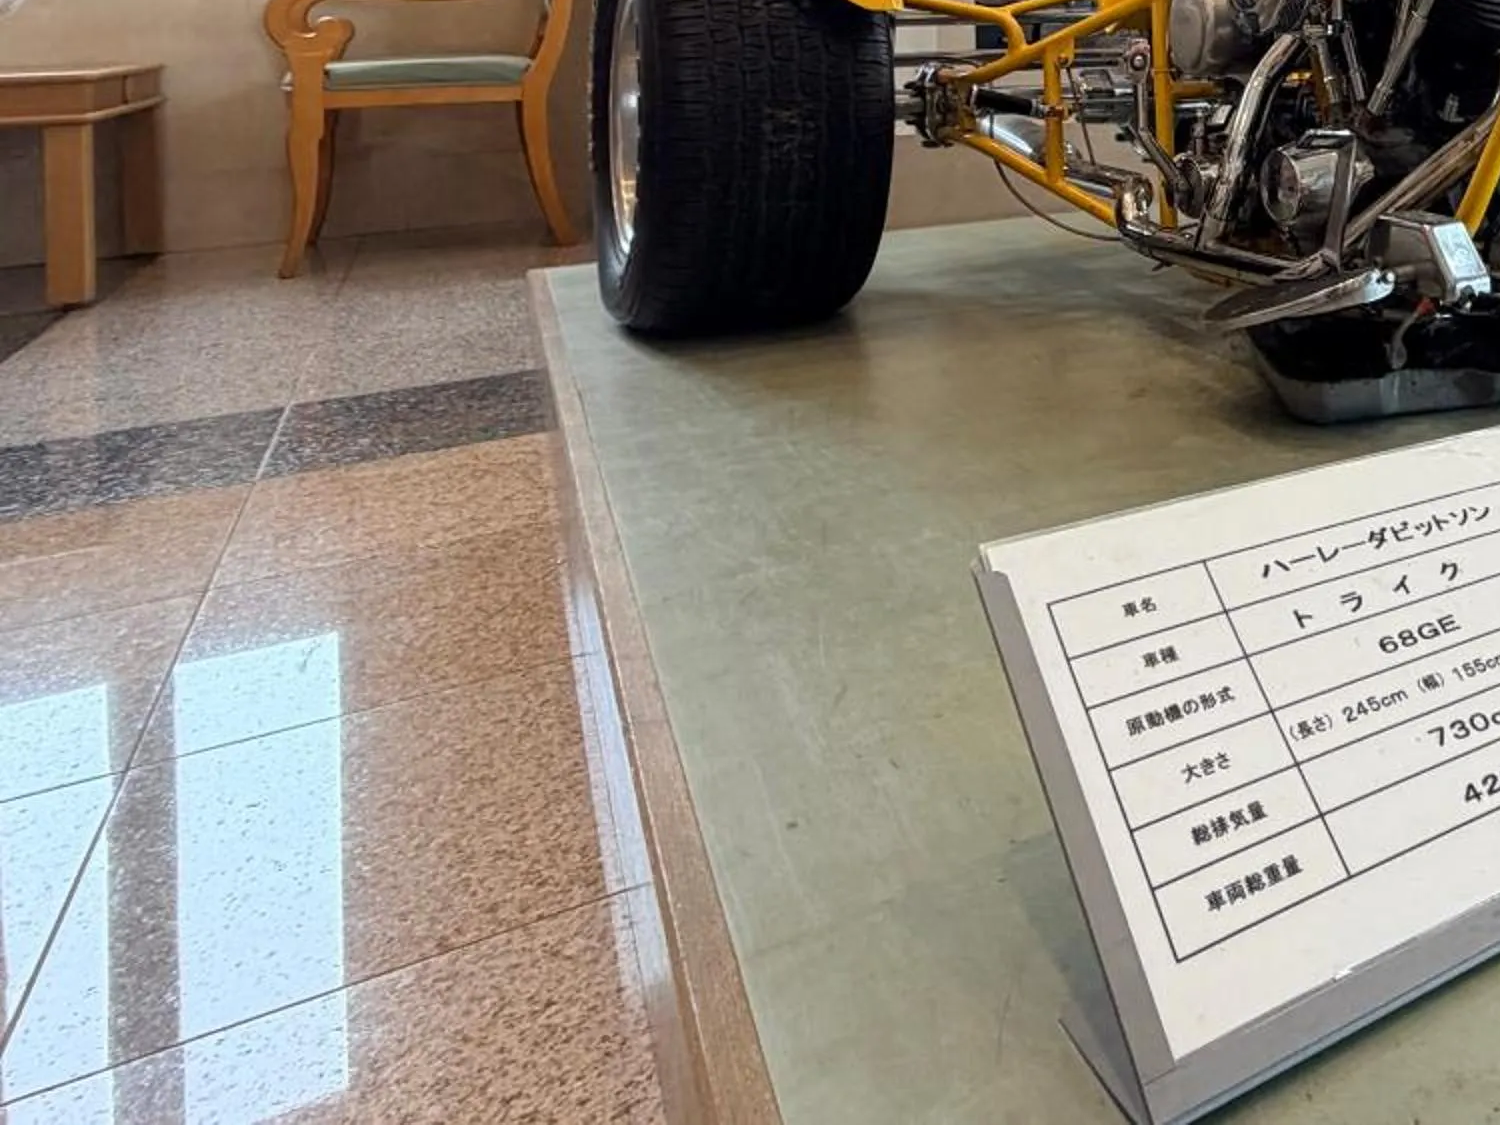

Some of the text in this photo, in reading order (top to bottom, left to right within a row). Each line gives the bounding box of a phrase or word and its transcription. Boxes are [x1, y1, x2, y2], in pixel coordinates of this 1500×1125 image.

[1122, 596, 1157, 617] 車名
[1379, 614, 1462, 654] 68GE
[1142, 645, 1179, 668] 車種
[1125, 685, 1236, 736] 原動機の形式
[1342, 689, 1409, 723] 245cm
[1180, 751, 1231, 784] 大きさ
[1191, 800, 1268, 846] 総排気量
[1204, 854, 1304, 912] 車両総重量
